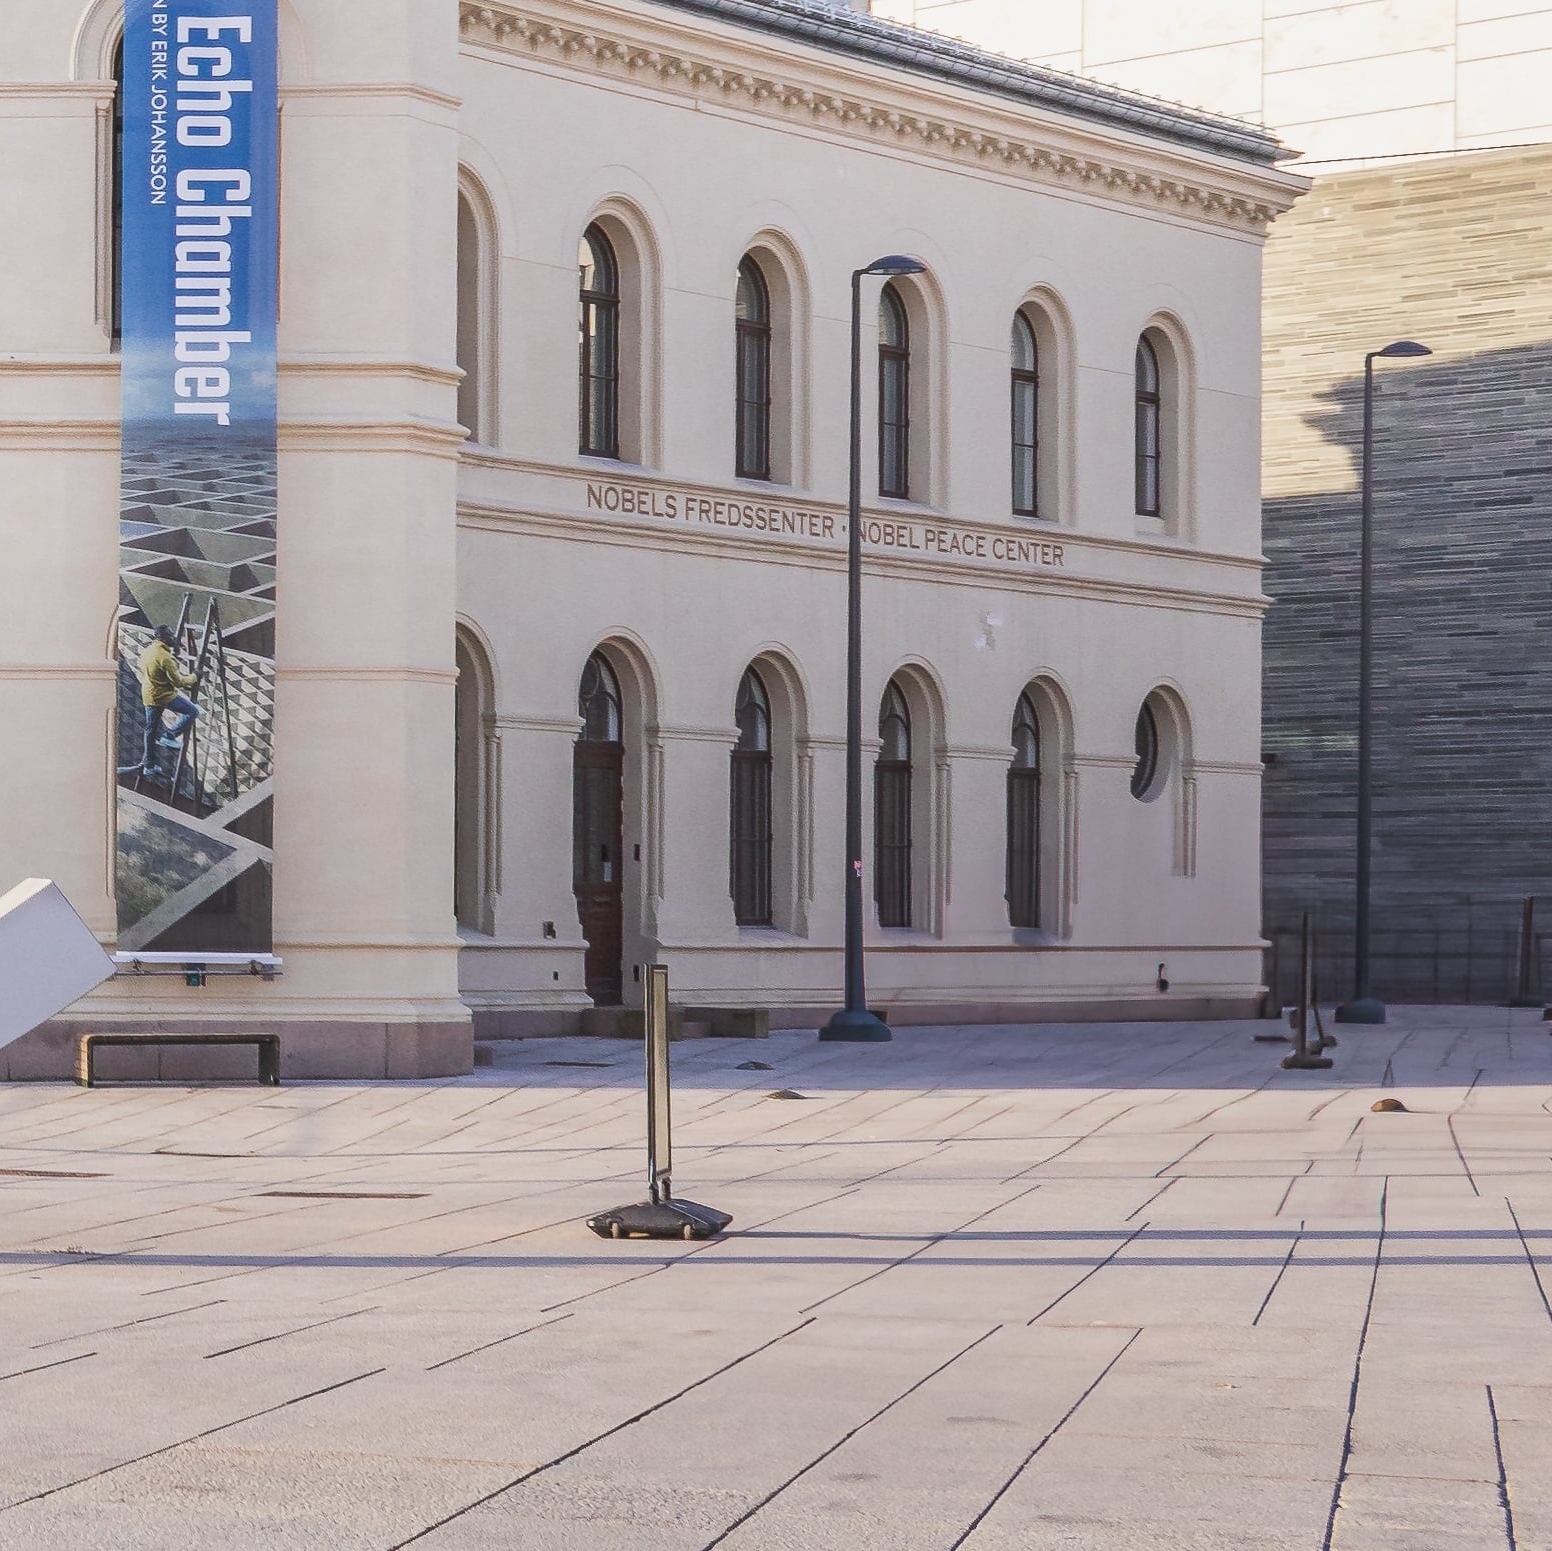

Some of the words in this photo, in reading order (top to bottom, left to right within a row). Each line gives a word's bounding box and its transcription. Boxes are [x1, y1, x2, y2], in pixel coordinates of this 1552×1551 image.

[151, 40, 168, 80] ERIK
[152, 13, 168, 36] BY
[176, 15, 253, 147] Echo
[150, 84, 168, 205] JOHANSSON
[173, 168, 253, 426] Chamber
[586, 483, 677, 519] NOBELS
[685, 497, 834, 538] FREDSSENTER
[925, 528, 986, 558] PEACE
[993, 537, 1065, 567] CENTER
